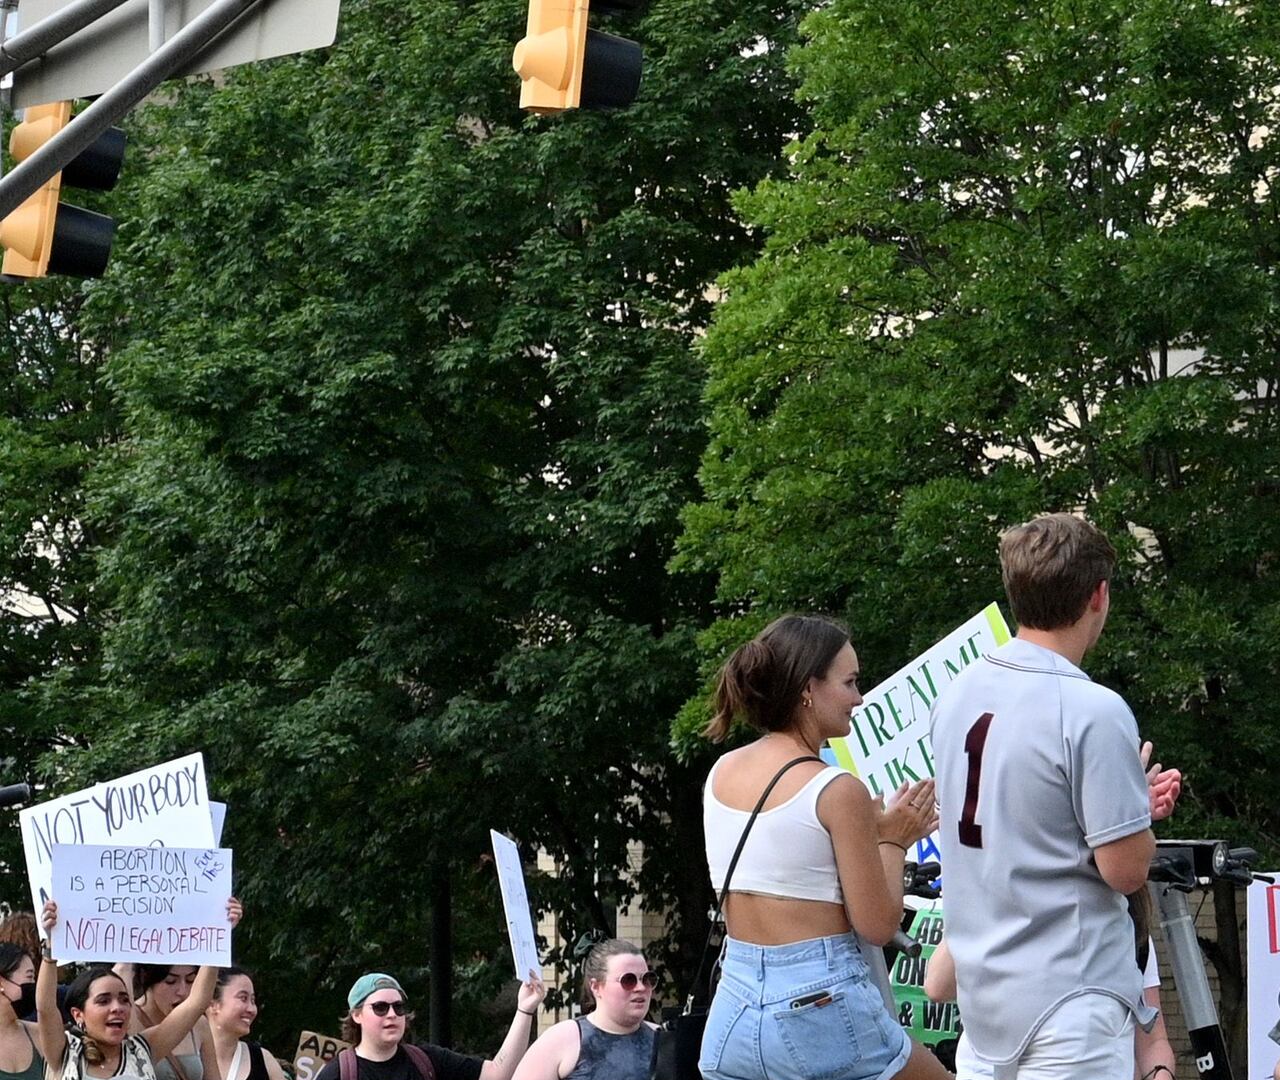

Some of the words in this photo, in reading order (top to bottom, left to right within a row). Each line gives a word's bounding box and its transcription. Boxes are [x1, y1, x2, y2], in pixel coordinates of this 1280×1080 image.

[850, 660, 938, 758] TREAT
[957, 712, 994, 848] 1
[32, 799, 89, 864] NOT
[92, 782, 148, 837] YOUR
[150, 762, 199, 815] BODY
[101, 849, 187, 876] ABORTION
[70, 876, 85, 891] IS
[95, 878, 105, 891] A
[111, 876, 208, 894] PERSONAL
[95, 896, 175, 915] DECISION
[66, 917, 106, 950] NOT
[104, 923, 116, 948] A
[120, 927, 164, 955] LEGAL
[168, 927, 227, 953] DEBATE
